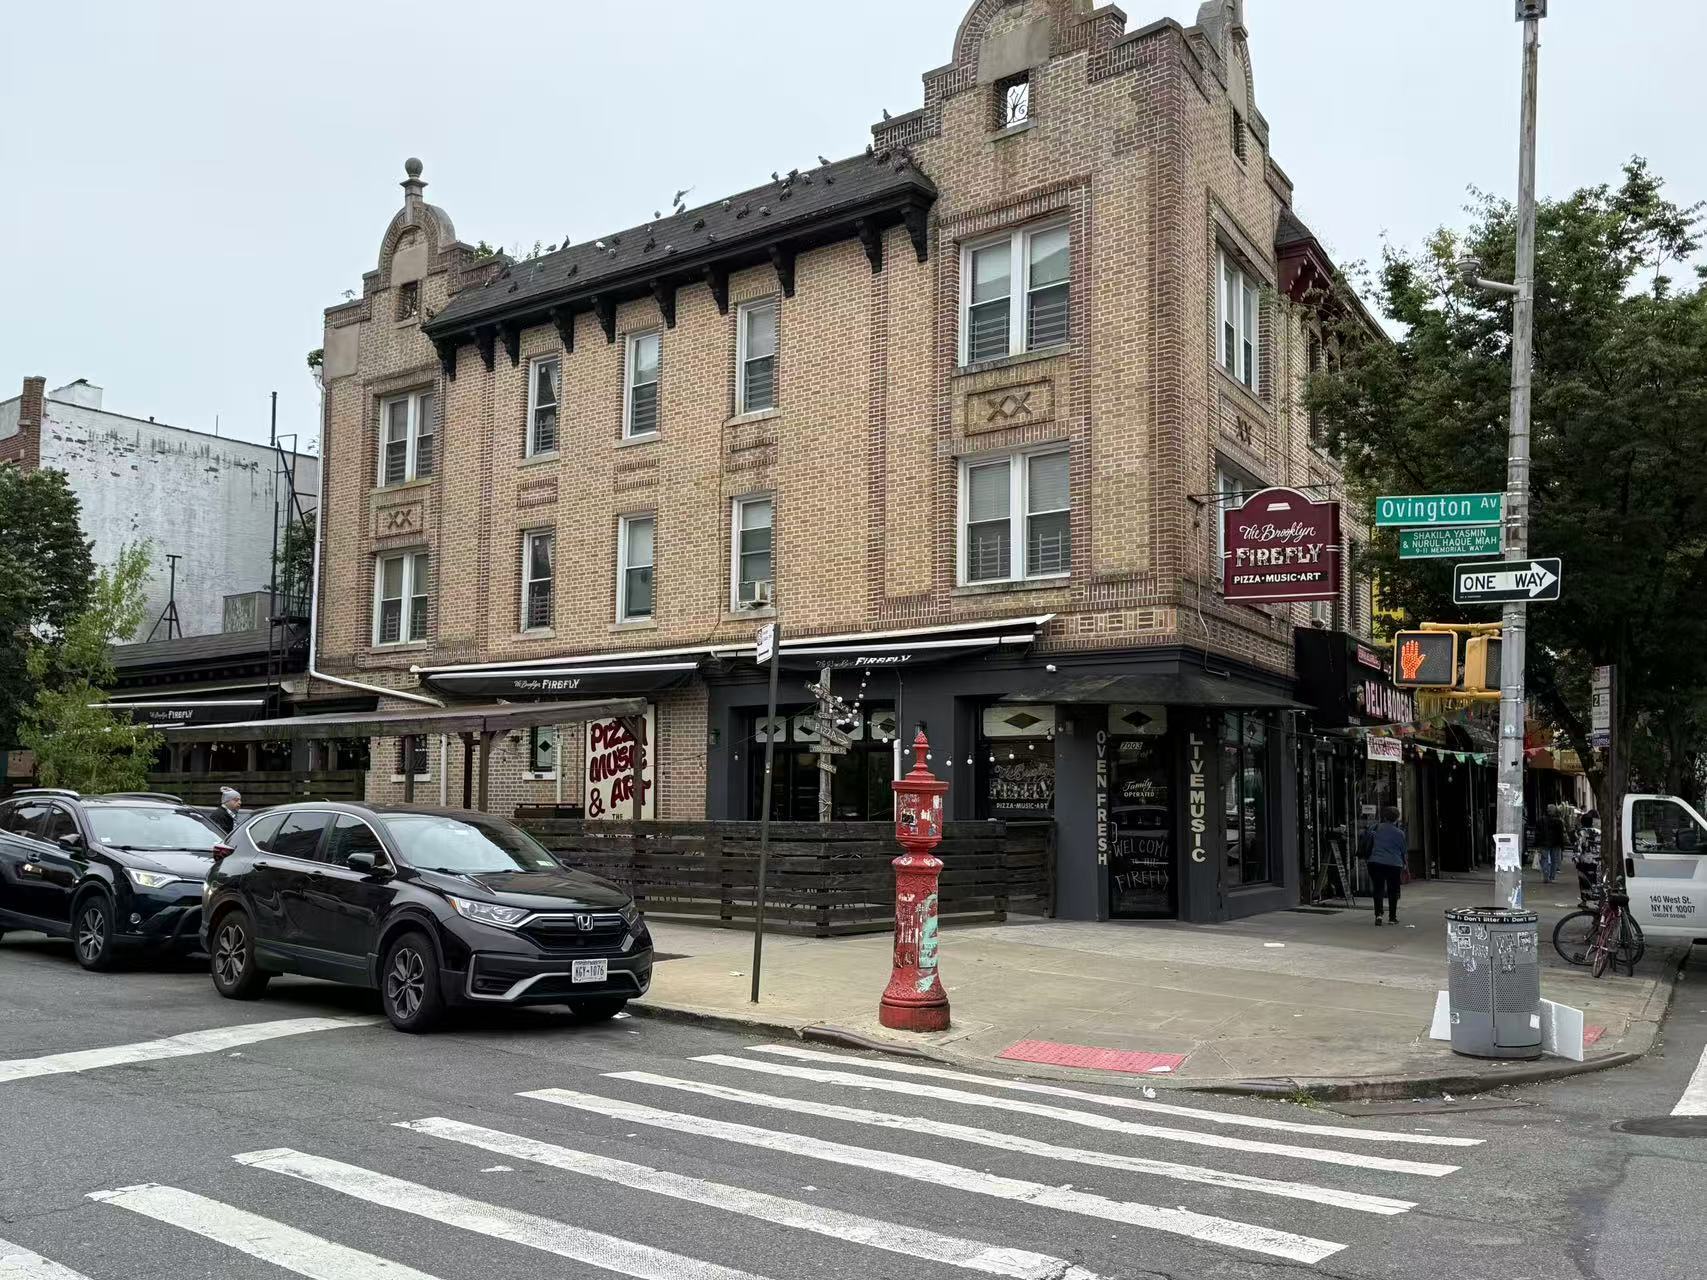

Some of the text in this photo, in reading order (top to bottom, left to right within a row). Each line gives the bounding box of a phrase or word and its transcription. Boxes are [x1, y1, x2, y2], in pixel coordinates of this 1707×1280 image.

[1382, 497, 1497, 521] Ovington Av
[1239, 521, 1316, 543] The Brooklyn
[1413, 529, 1486, 540] SHAKILA YASMIN
[1402, 536, 1497, 549] & NURUL HAQUE MIAH
[1235, 543, 1324, 567] FIREFLY
[1463, 571, 1547, 590] ONE WAY
[542, 678, 581, 689] FIREFLY
[168, 710, 193, 719] FIREFLY
[815, 722, 837, 739] PIZZA
[1122, 778, 1153, 792] Family
[589, 788, 605, 818] &
[1096, 730, 1108, 866] OVEN FRESH
[1189, 732, 1206, 863] LIVE MUSIC
[1649, 895, 1692, 904] 140 West St.
[1650, 904, 1696, 913] NY NY 10007
